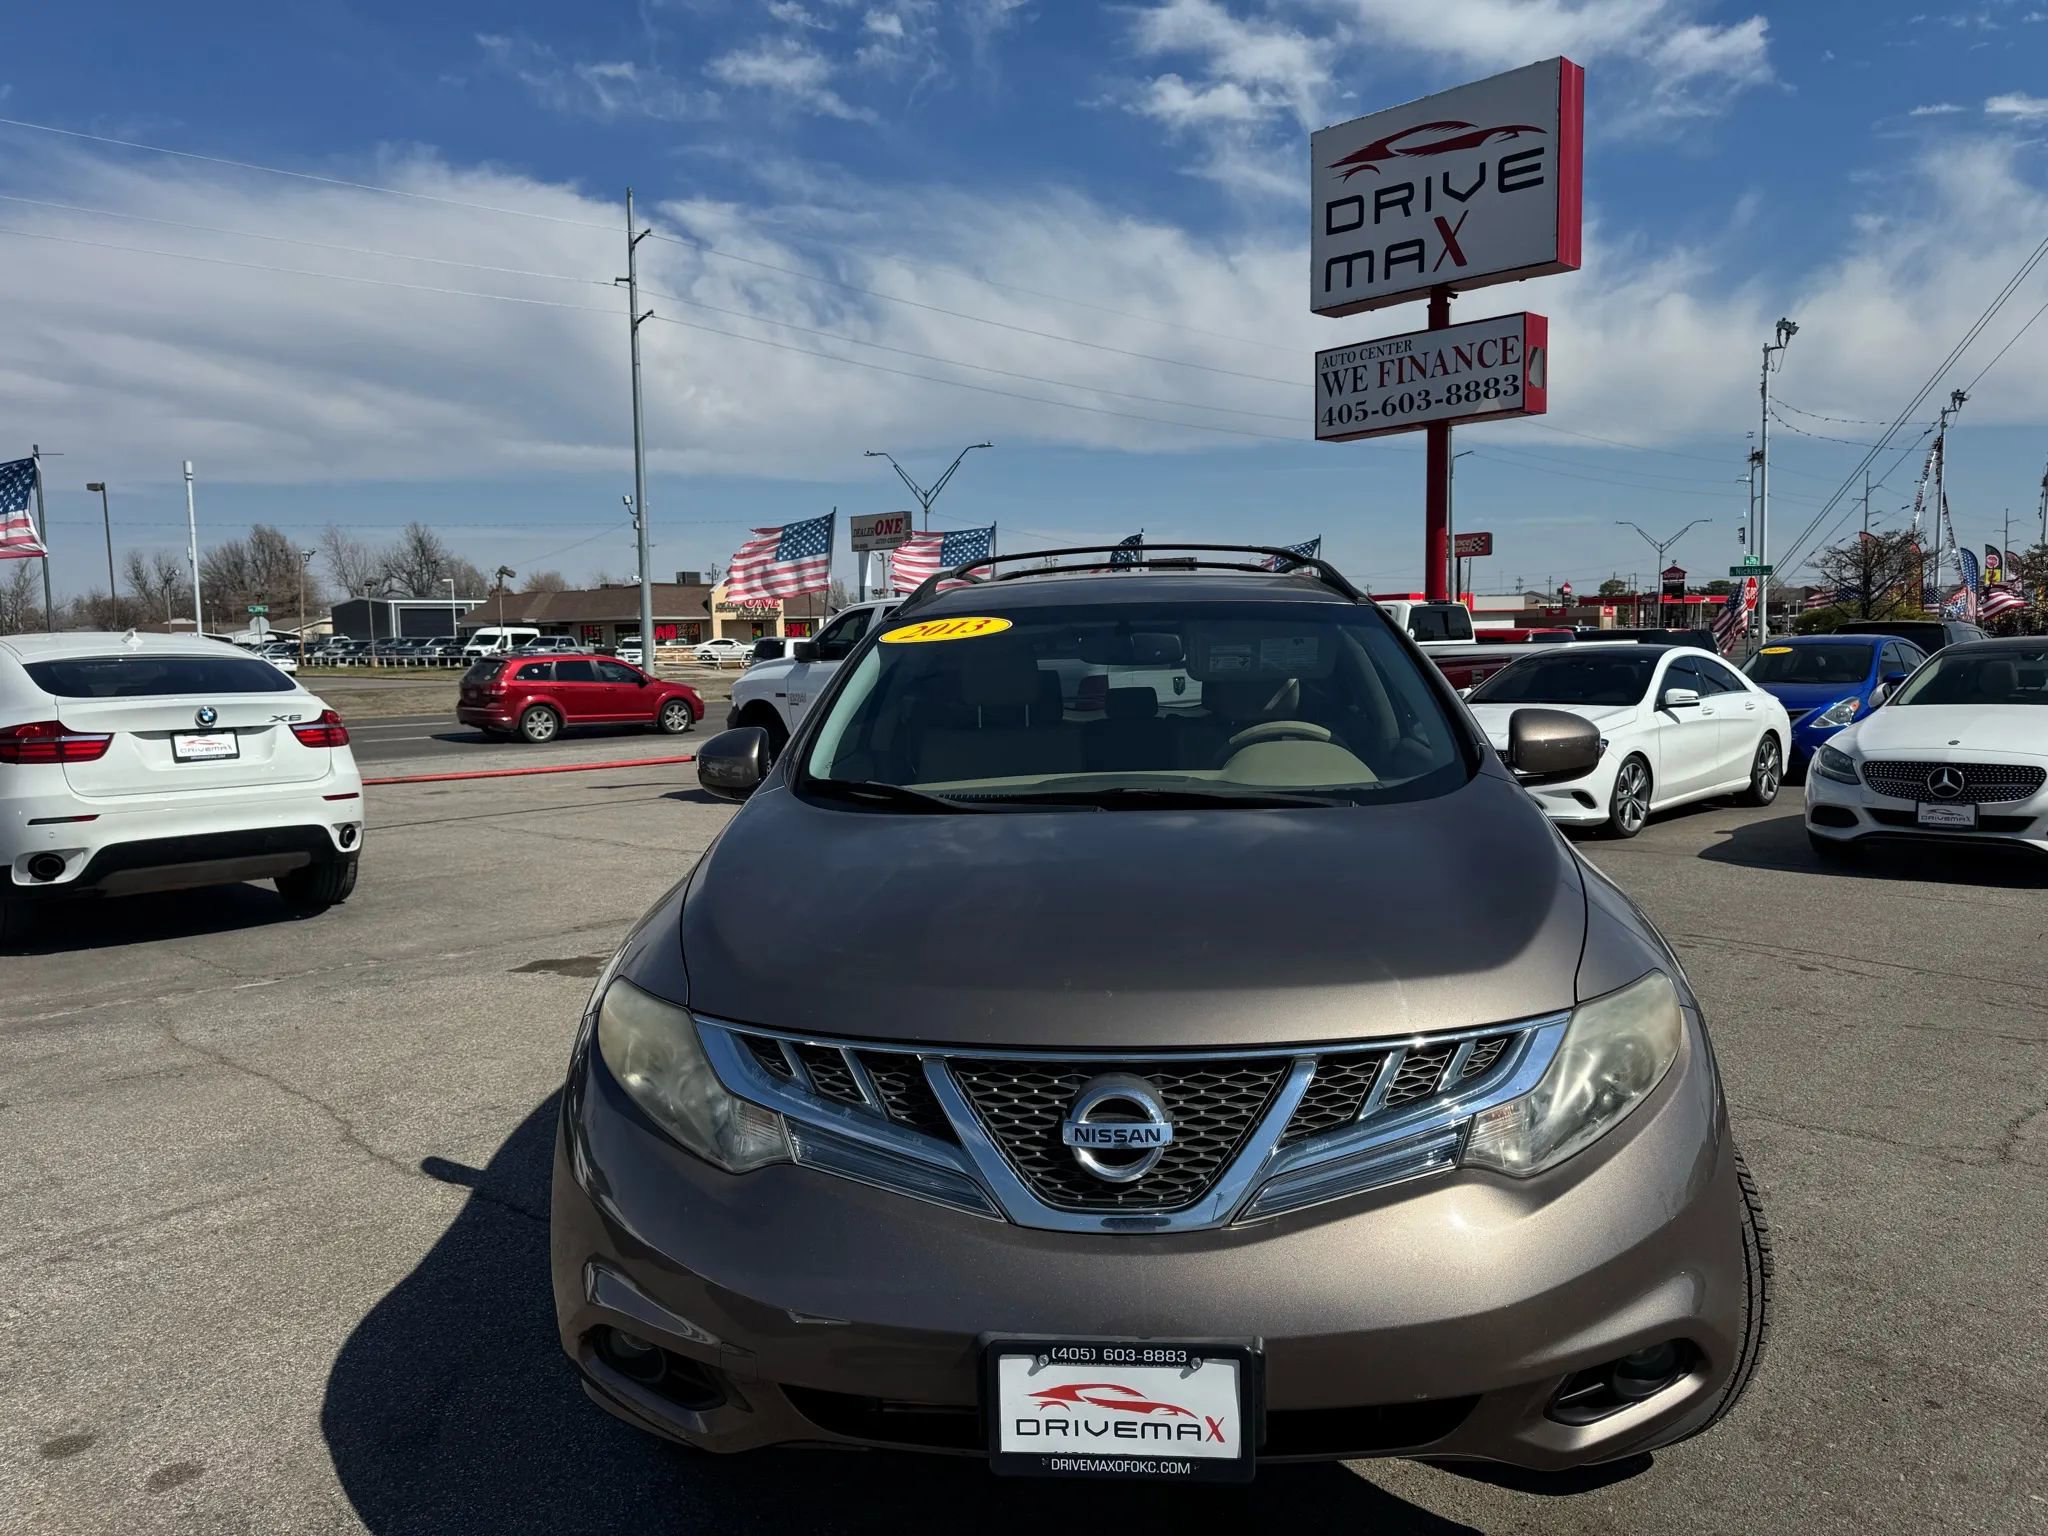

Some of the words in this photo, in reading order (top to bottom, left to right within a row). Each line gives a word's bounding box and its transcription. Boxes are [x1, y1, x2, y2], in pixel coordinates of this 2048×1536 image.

[1326, 147, 1545, 235] DRIVE
[1325, 209, 1468, 292] MAX
[1320, 364, 1369, 398] WE
[1376, 335, 1521, 389] FINANCE
[1322, 350, 1356, 370] AUTO
[1360, 339, 1413, 360] CENTER
[1321, 374, 1520, 427] 405-603-8883
[875, 518, 903, 535] ONE
[897, 619, 993, 636] 2013
[1074, 1127, 1160, 1143] NISSAN
[1051, 1347, 1096, 1361] (405)
[1103, 1348, 1187, 1363] 603-8883
[1016, 1415, 1226, 1443] DRIVEMAX
[1051, 1458, 1191, 1475] DRIVEMAXOFOKC.COM
